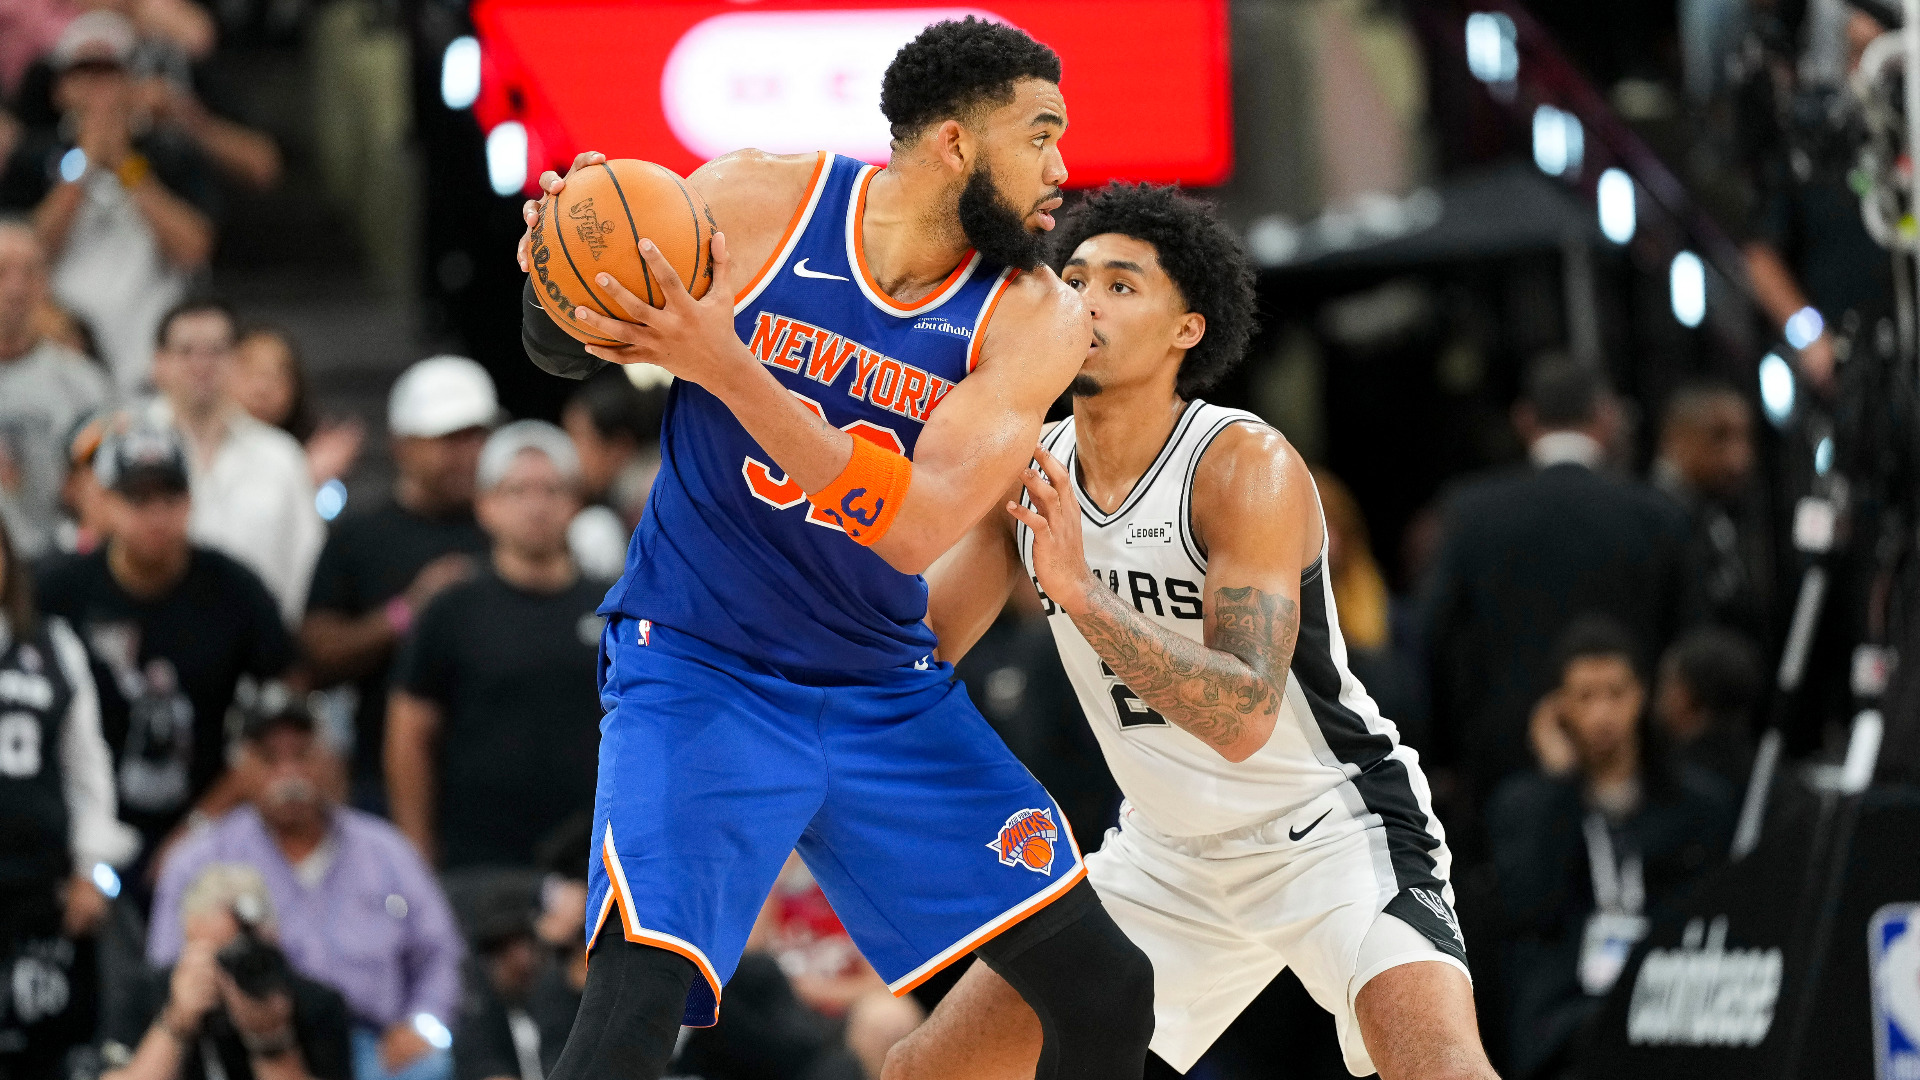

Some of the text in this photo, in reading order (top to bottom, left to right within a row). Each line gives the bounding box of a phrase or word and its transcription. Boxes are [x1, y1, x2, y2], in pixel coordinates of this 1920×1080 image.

[913, 321, 973, 339] abu dhabi
[748, 311, 859, 387] NEW
[1131, 528, 1165, 538] LEDGER
[1032, 569, 1204, 620] SRS
[1222, 613, 1254, 633] 24
[1001, 811, 1056, 861] KNICKS
